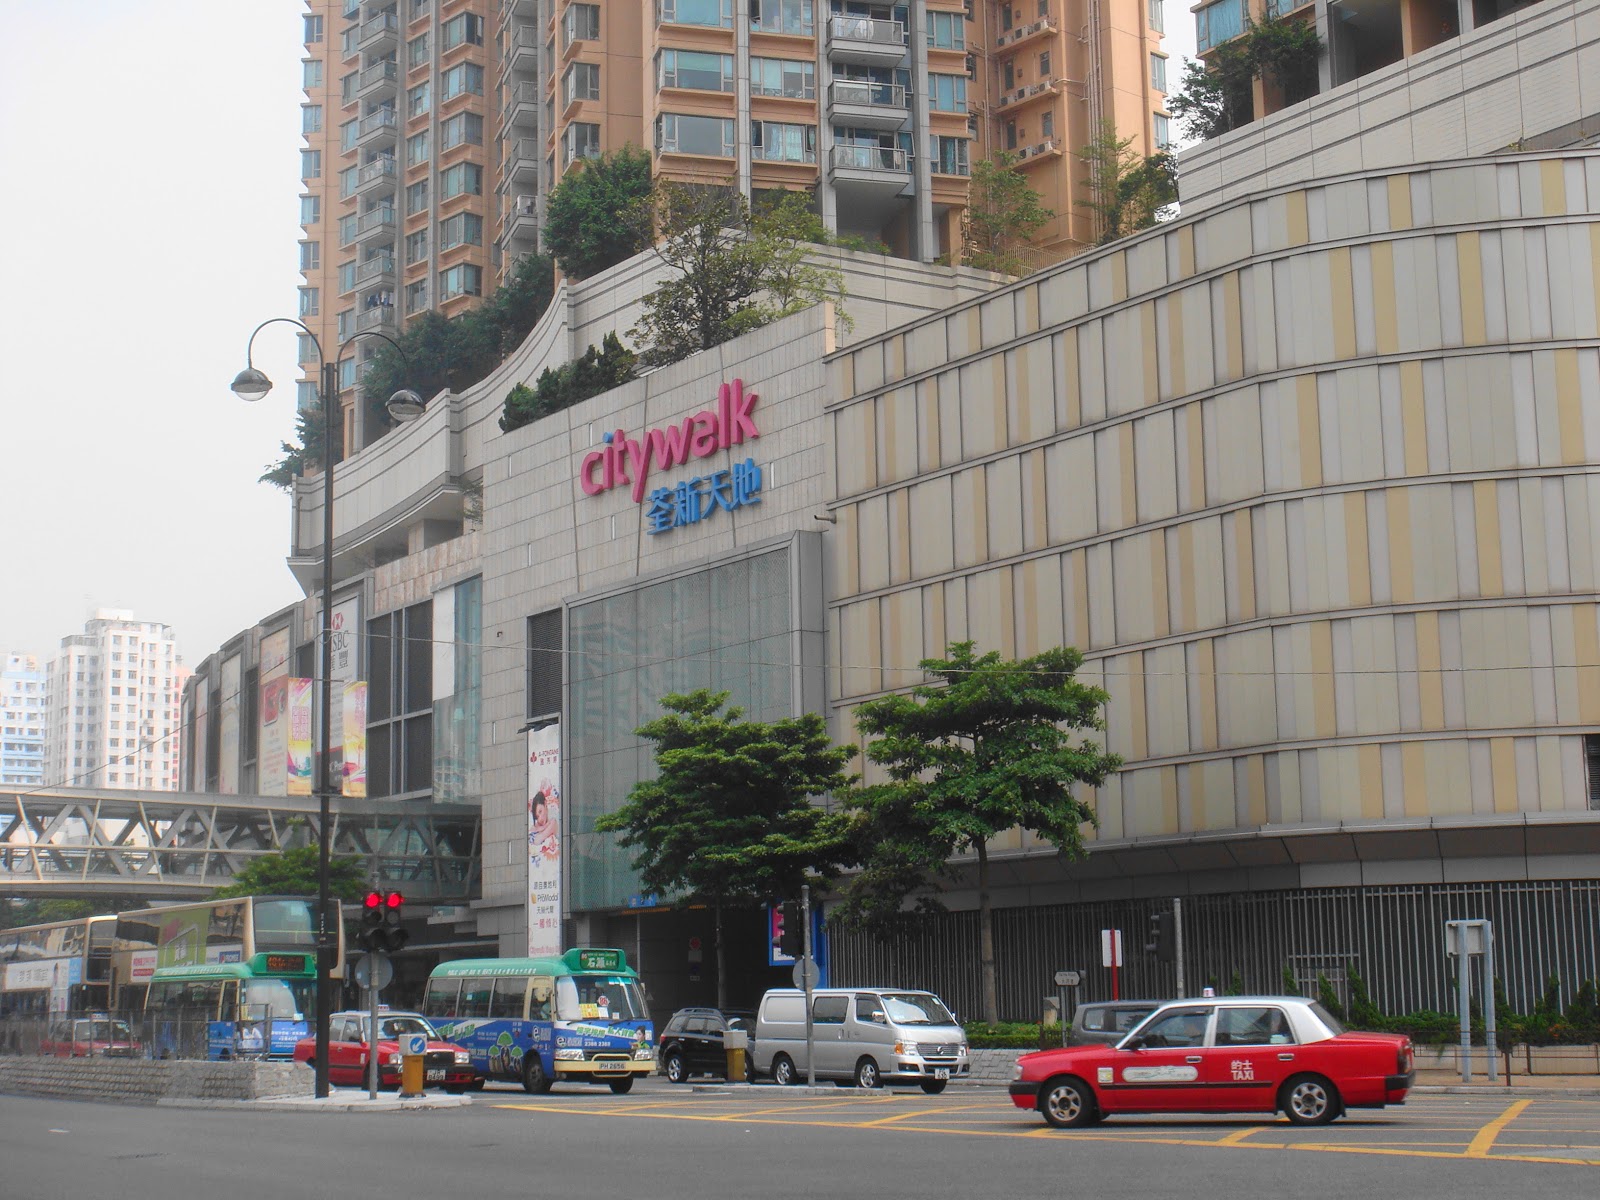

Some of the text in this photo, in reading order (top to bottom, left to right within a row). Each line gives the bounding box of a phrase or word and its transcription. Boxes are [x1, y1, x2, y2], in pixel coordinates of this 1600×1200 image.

[580, 378, 760, 503] citywalk
[646, 458, 762, 535] 荃新天地
[331, 630, 349, 652] SBC
[1231, 1060, 1253, 1070] 的士
[1231, 1070, 1254, 1080] TAXI
